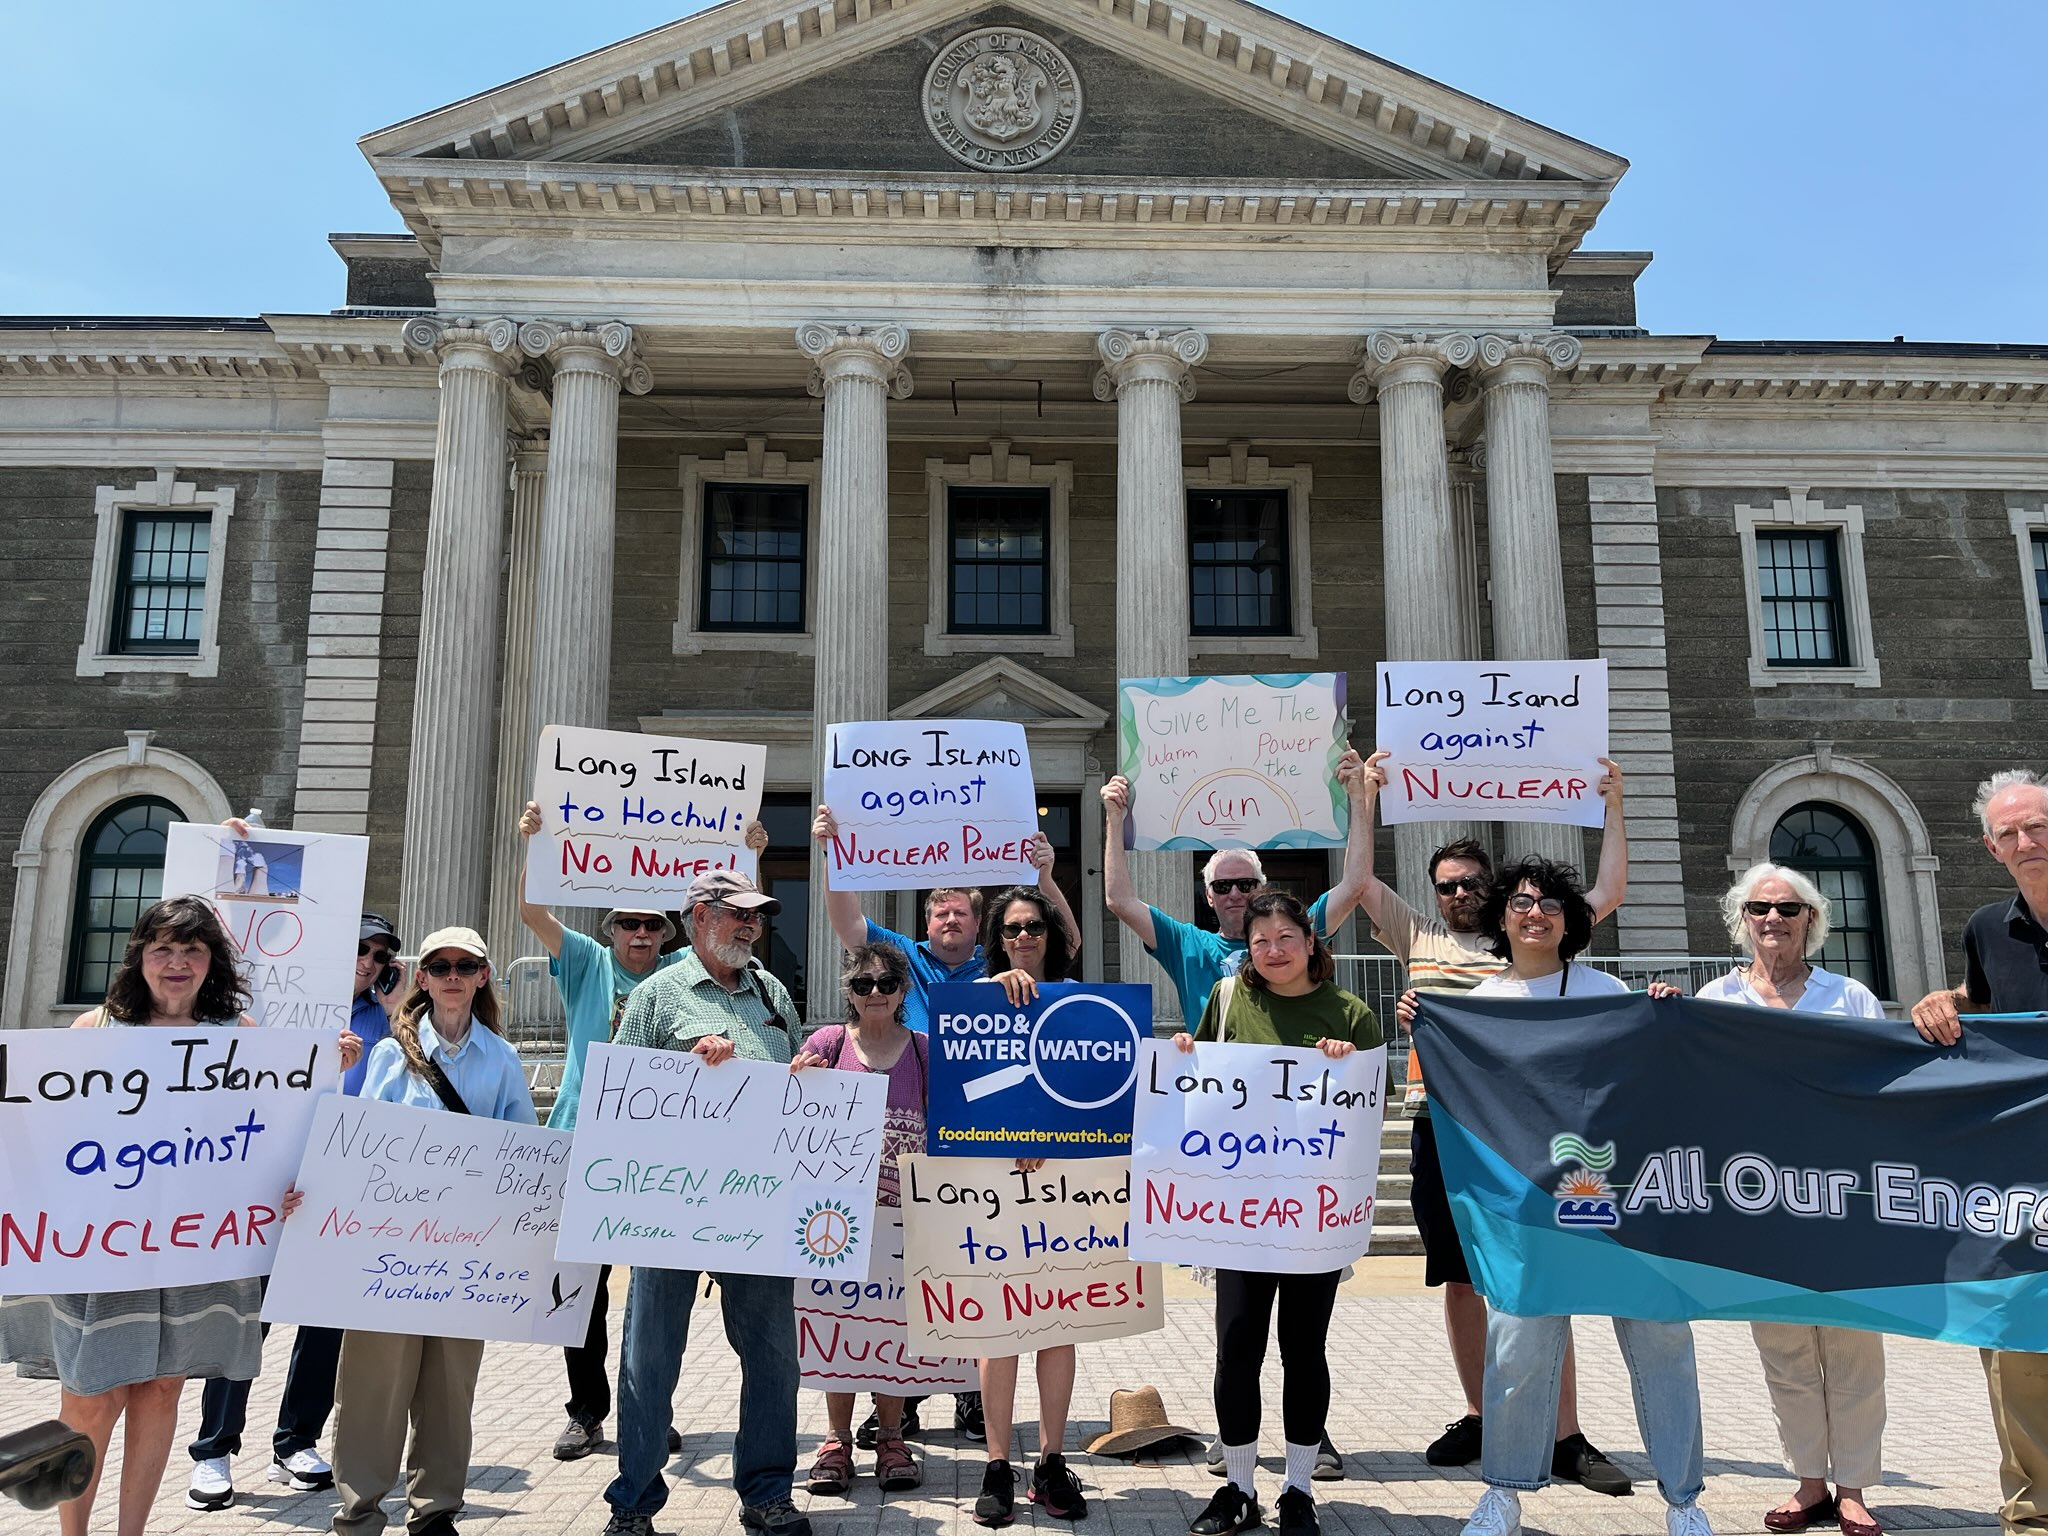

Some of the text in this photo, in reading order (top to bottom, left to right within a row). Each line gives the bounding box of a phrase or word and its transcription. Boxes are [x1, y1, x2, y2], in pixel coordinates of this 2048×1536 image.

[933, 34, 1073, 89] COUNTY OF NASSAU
[934, 110, 1073, 166] STATE OF NEW YORK
[1221, 696, 1262, 729] Me
[1271, 694, 1320, 723] The
[1384, 671, 1464, 718] Long
[833, 730, 1021, 769] LONG ISLAND
[1147, 732, 1321, 769] Warm Power
[1420, 719, 1545, 761] against
[555, 737, 746, 790] Long Island
[1159, 759, 1302, 785] of the
[861, 774, 987, 817] against
[1402, 767, 1588, 802] NUCLEAR
[559, 792, 743, 832] to Hochul:
[1197, 790, 1261, 826] Sun
[630, 845, 736, 878] NUKE!
[833, 825, 1035, 870] NUCLEAR POWER
[942, 1039, 1131, 1062] WATER WATCH
[0, 1039, 318, 1115] Long Island
[1149, 1051, 1380, 1110] Long Island
[66, 1108, 265, 1189] against
[773, 1126, 875, 1157] NUKE
[938, 1126, 1133, 1144] foodandwaterwatch.or
[1180, 1119, 1346, 1171] against
[361, 1164, 453, 1203] Power
[584, 1158, 709, 1196] GREEN
[719, 1168, 783, 1198] PARTY
[791, 1152, 875, 1183] NY!
[1625, 1148, 1711, 1211] All
[1723, 1154, 1858, 1216] Our
[910, 1162, 1130, 1220] Long Island
[1145, 1178, 1373, 1233] NUCLEAR POWER
[1, 1204, 277, 1267] NUCLEAR
[319, 1207, 361, 1238] No
[368, 1217, 403, 1238] to
[513, 1212, 559, 1237] People
[959, 1221, 1129, 1265] to Hochul
[362, 1254, 530, 1281] South Shore
[363, 1278, 531, 1313] Audubon Society
[799, 1316, 978, 1370] NUCL
